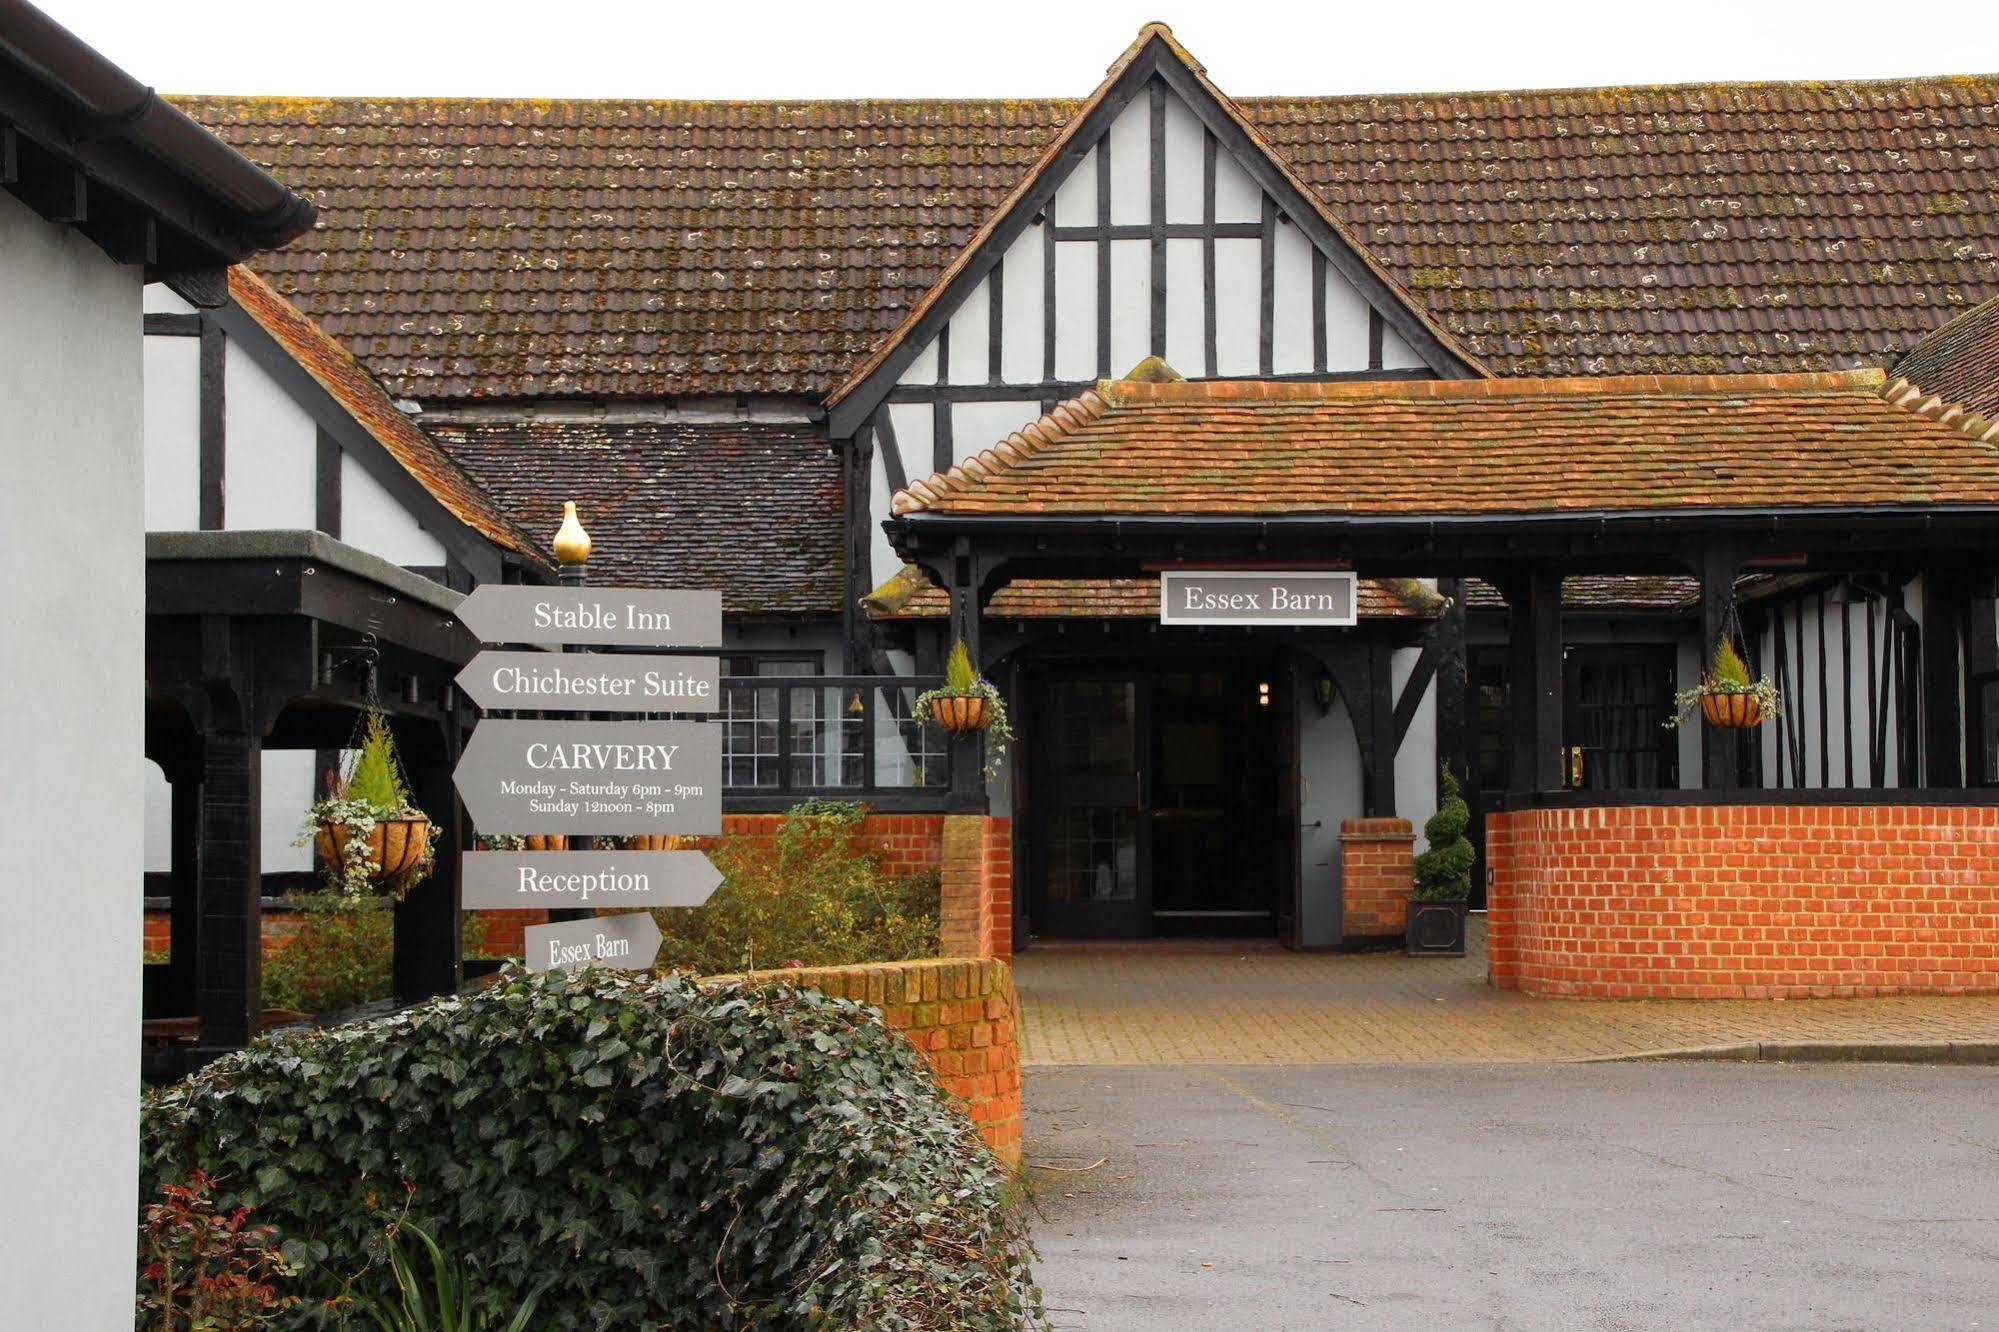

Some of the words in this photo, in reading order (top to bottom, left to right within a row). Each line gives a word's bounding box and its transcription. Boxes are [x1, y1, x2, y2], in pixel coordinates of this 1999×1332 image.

[1184, 586, 1260, 610] Essex
[1270, 586, 1334, 610] Barn
[534, 602, 617, 629] Stable
[626, 605, 672, 630] Inn
[492, 667, 636, 696] Chichester
[644, 671, 710, 697] Suite
[526, 743, 679, 770] CARVERY
[500, 781, 556, 798] Monday
[569, 781, 629, 799] Saturday
[632, 784, 661, 799] 6pm
[674, 784, 703, 799] 9pm
[530, 799, 579, 816] Sunday
[585, 800, 632, 813] 12noon
[646, 801, 674, 816] 8pm
[518, 866, 650, 900] Reception
[549, 939, 591, 967] Essex
[596, 933, 629, 959] Barn
